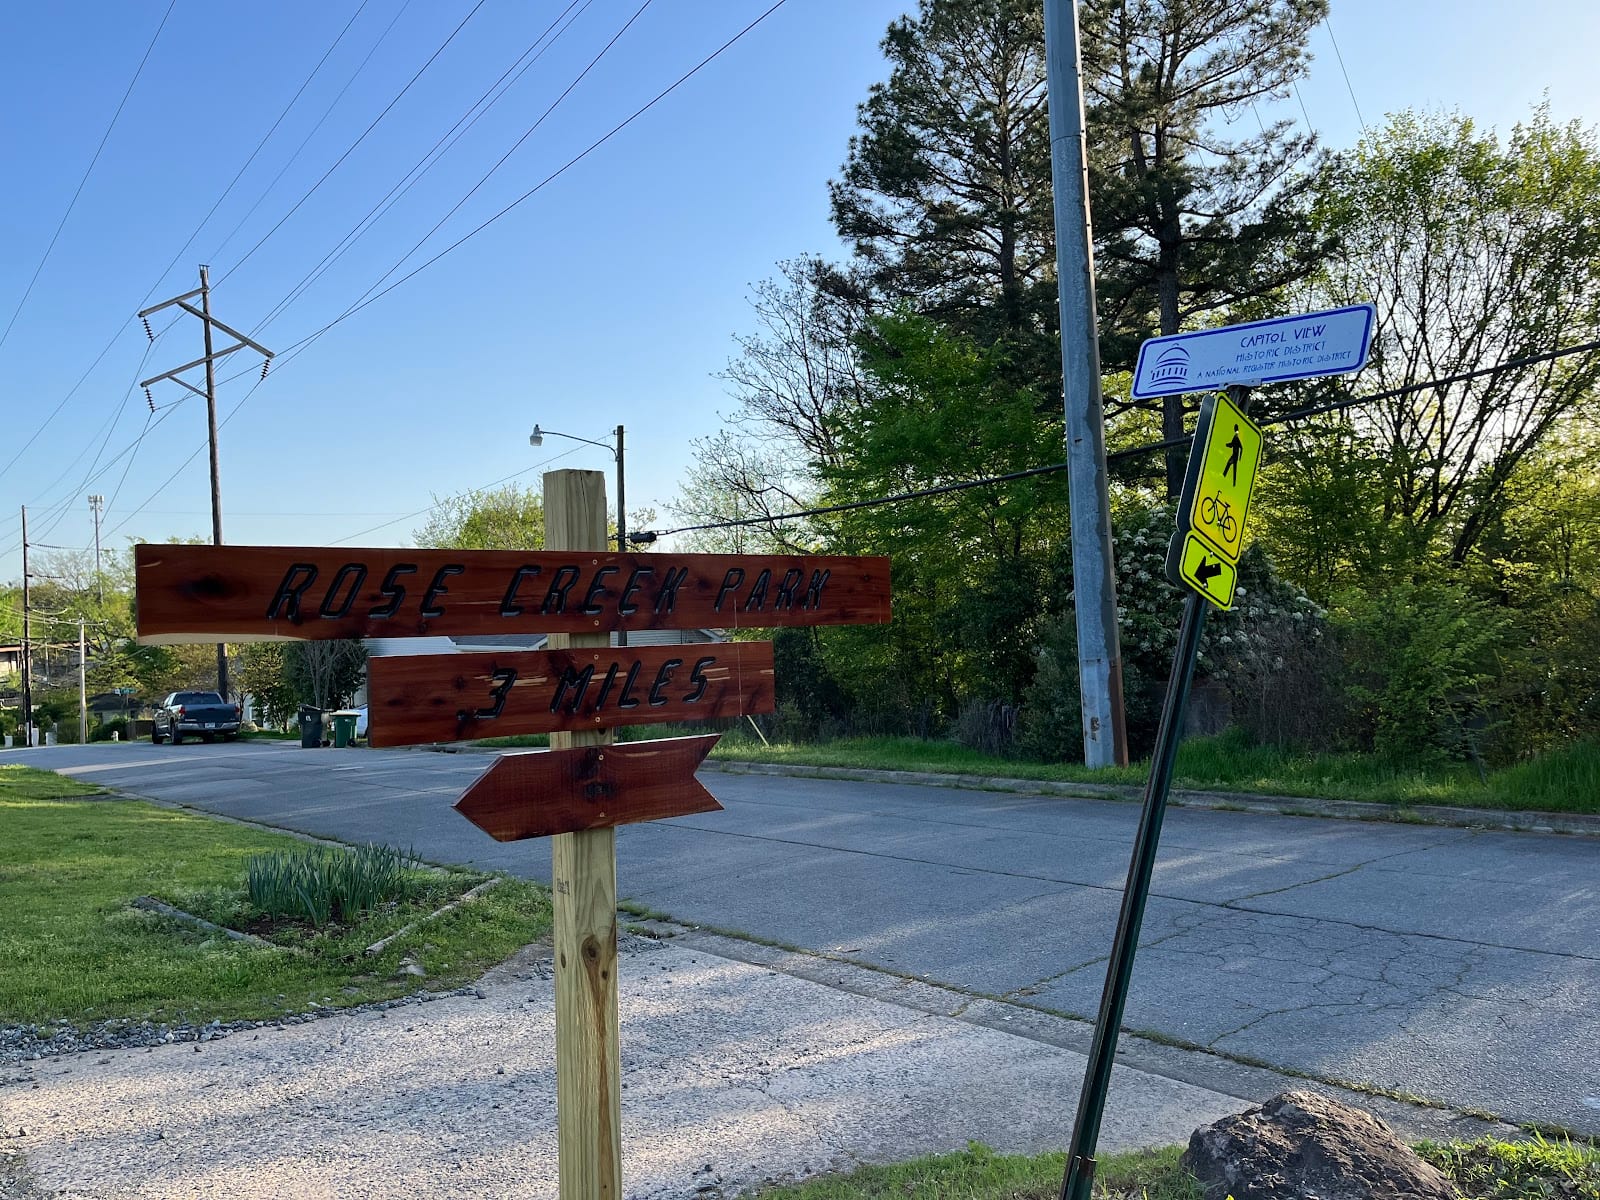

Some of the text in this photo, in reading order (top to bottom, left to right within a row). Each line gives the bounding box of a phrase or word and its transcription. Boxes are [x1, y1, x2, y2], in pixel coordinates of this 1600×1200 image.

[1240, 324, 1326, 348] CAPITOL VIEW
[1196, 350, 1352, 379] A NATIONAL REGISTER HISTORIC DISTRICT
[1236, 341, 1326, 362] HISTORIC DISTRICT
[266, 562, 831, 620] ROSE CREEK PARK
[550, 656, 717, 715] MILES
